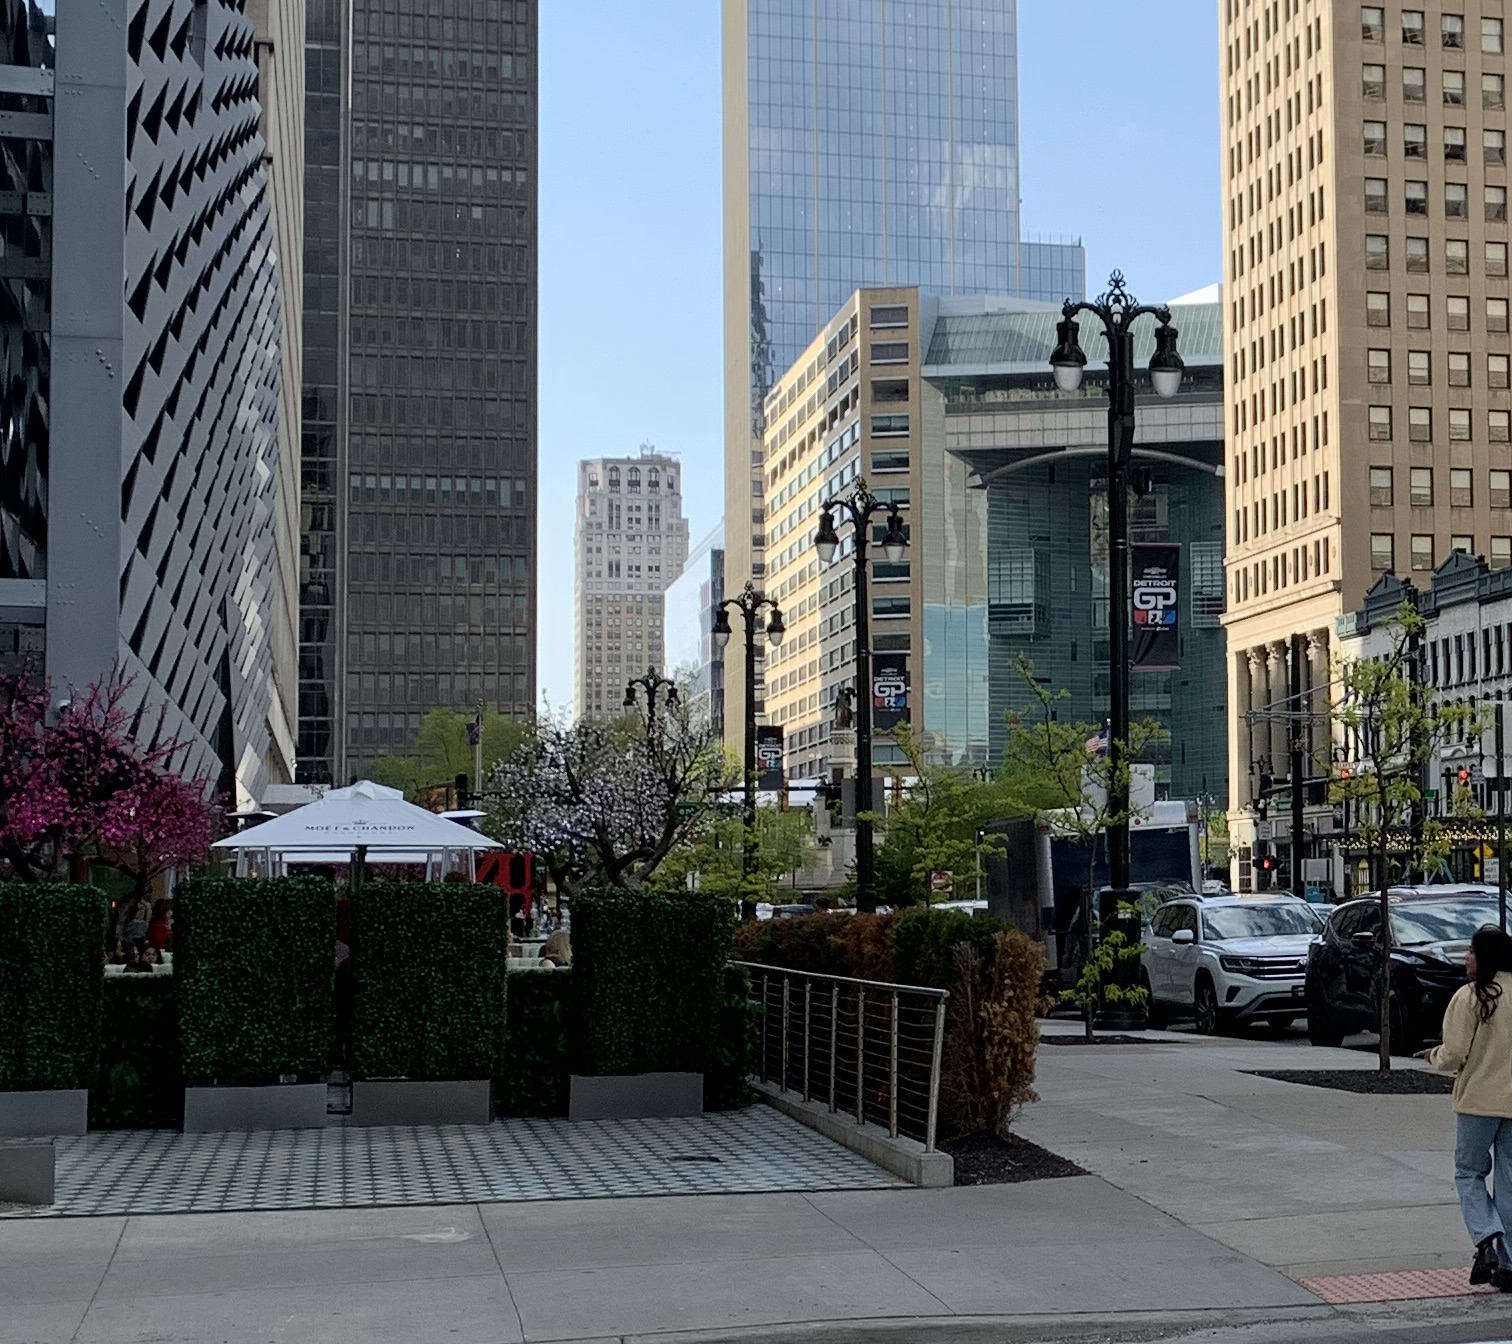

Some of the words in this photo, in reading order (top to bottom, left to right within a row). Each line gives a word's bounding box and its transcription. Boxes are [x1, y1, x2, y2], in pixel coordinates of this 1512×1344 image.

[1133, 579, 1177, 587] DETROIT
[1133, 587, 1177, 610] GP
[873, 681, 906, 697] GP
